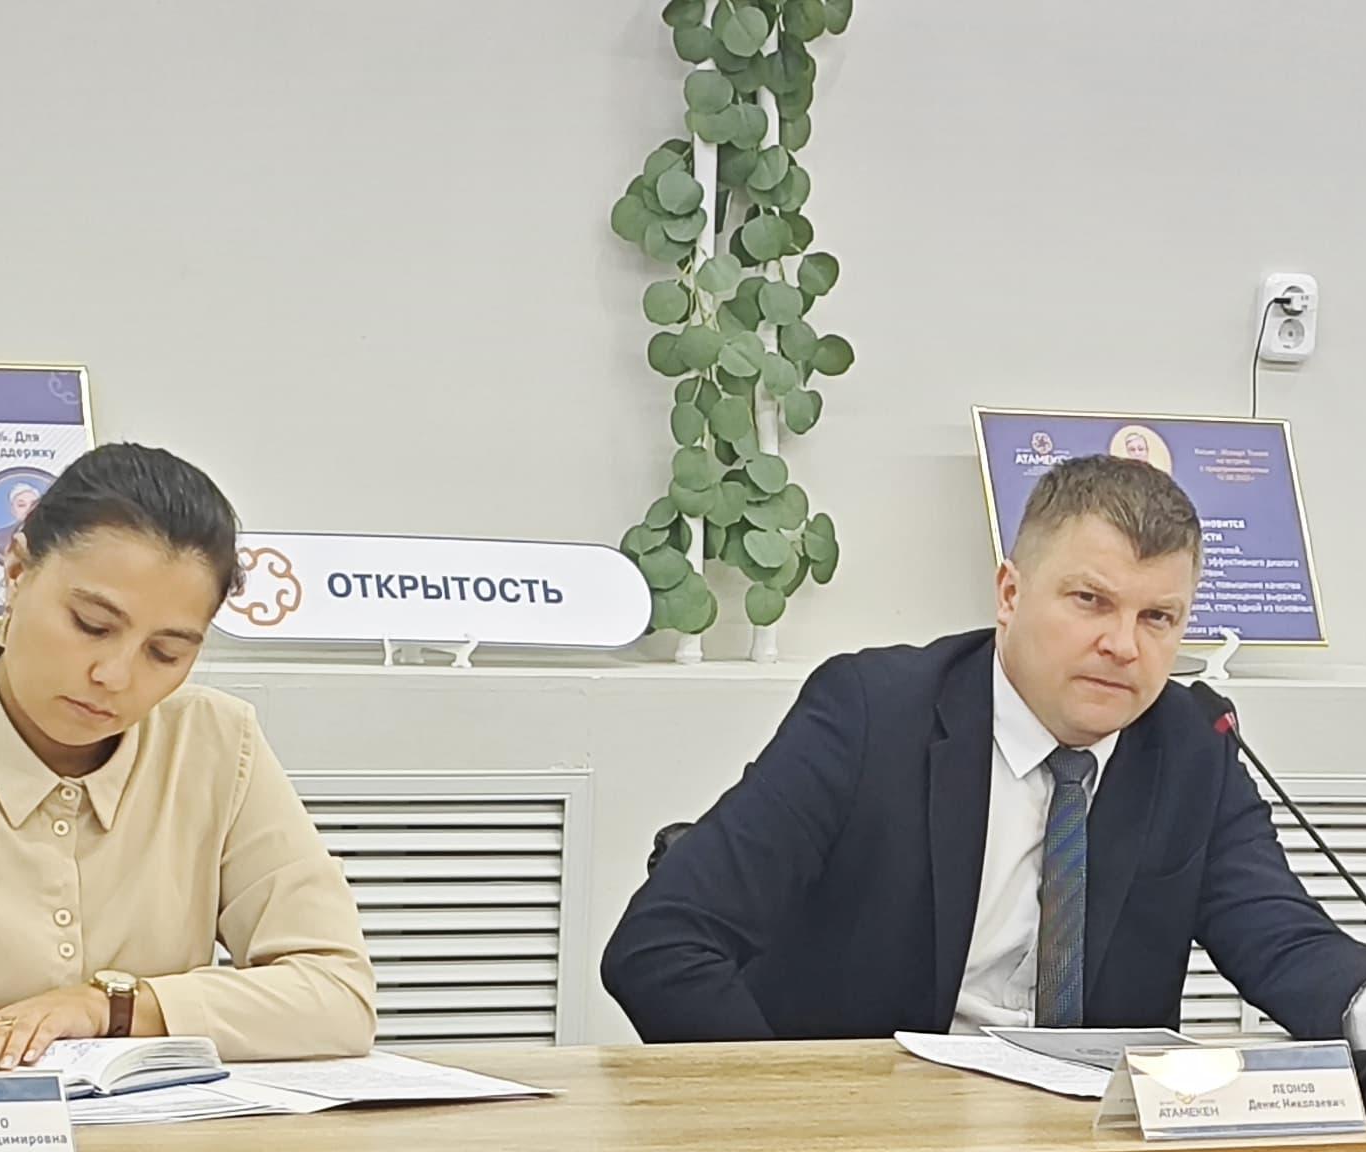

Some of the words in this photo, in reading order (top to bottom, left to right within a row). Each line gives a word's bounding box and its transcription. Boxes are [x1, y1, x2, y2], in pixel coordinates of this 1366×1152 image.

[326, 571, 565, 605] ОТКРЫТОСТЬ
[1272, 1083, 1315, 1095] ЛЕОНОВ
[1158, 1106, 1220, 1119] АТАМЕКЕН
